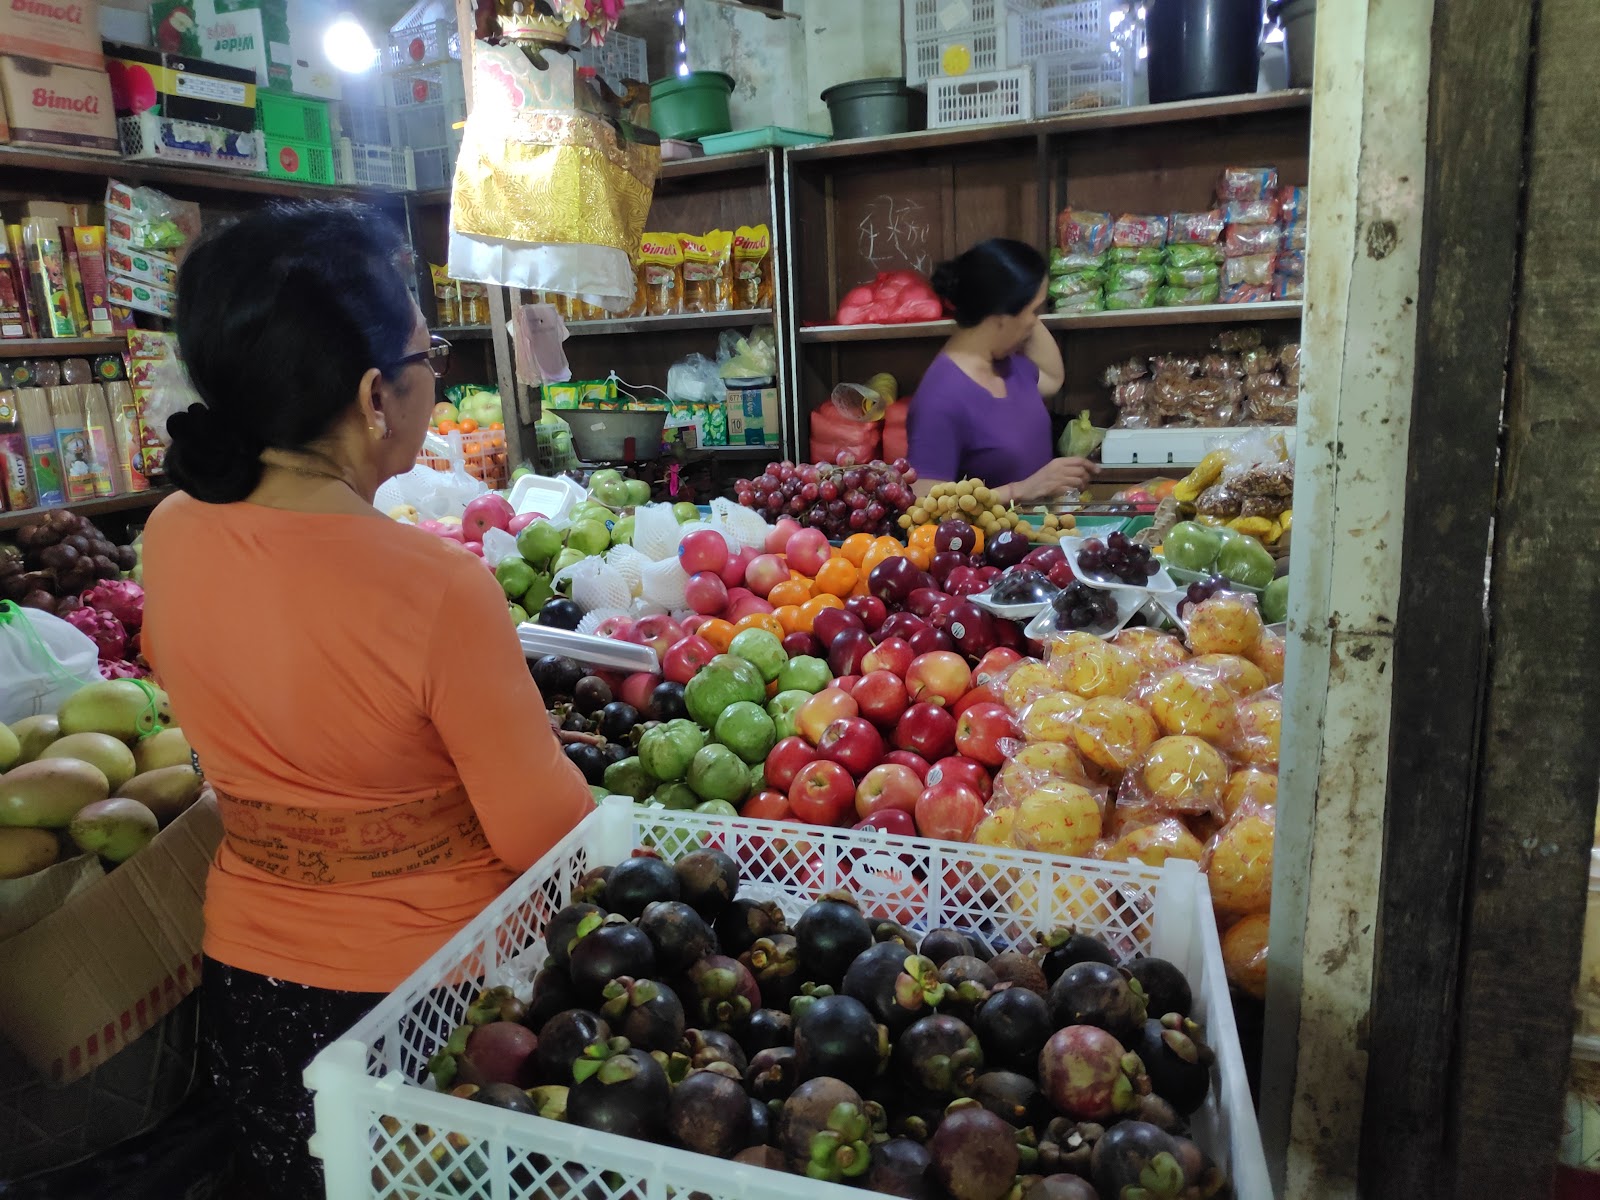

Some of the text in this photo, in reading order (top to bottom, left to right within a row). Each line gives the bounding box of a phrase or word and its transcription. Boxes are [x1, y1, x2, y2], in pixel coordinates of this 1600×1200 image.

[214, 34, 254, 51] Wider
[32, 88, 99, 114] Bimoli
[642, 243, 677, 256] Bimoli
[735, 235, 767, 250] Bimoli
[732, 420, 741, 430] 10
[16, 456, 26, 486] Glory
